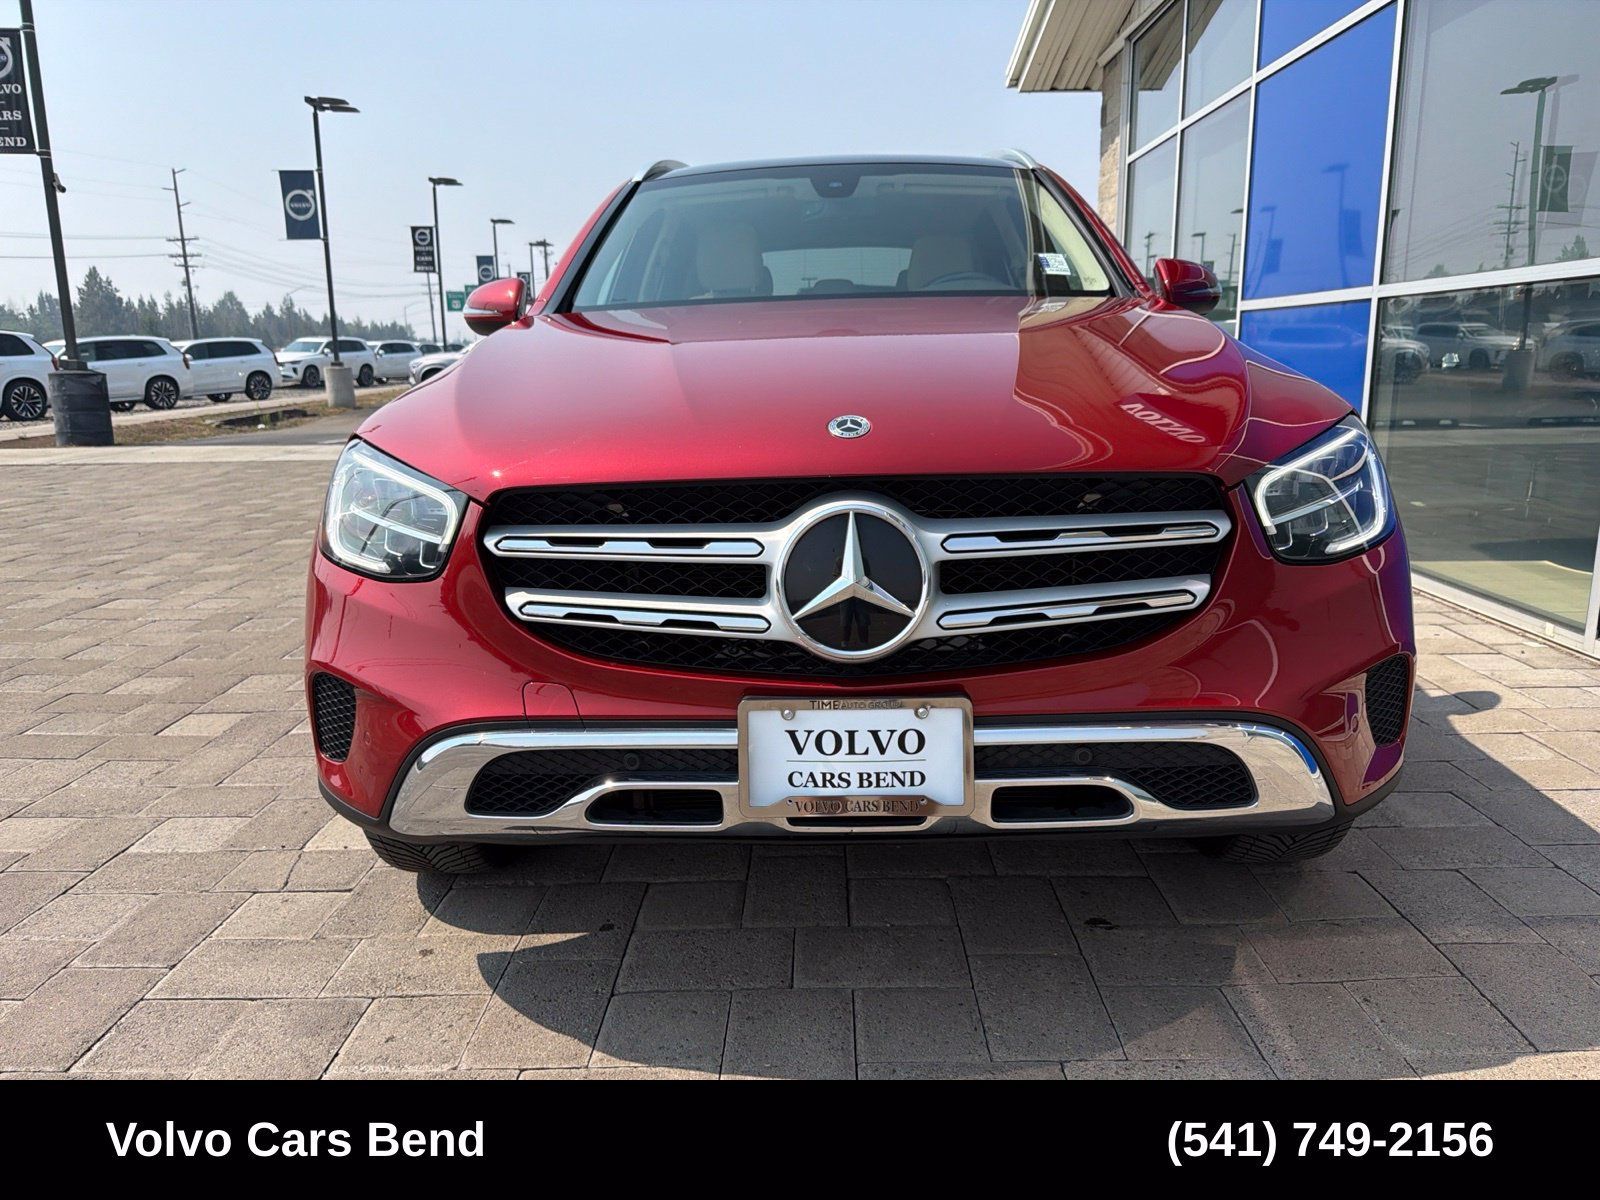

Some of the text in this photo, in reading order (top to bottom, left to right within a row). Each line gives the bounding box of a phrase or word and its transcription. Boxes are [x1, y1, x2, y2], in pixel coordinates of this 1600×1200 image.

[810, 700, 839, 710] TIME
[784, 728, 926, 756] VOLVO
[787, 771, 926, 789] CARS BEND
[795, 800, 919, 813] VOLVO CARS BEND
